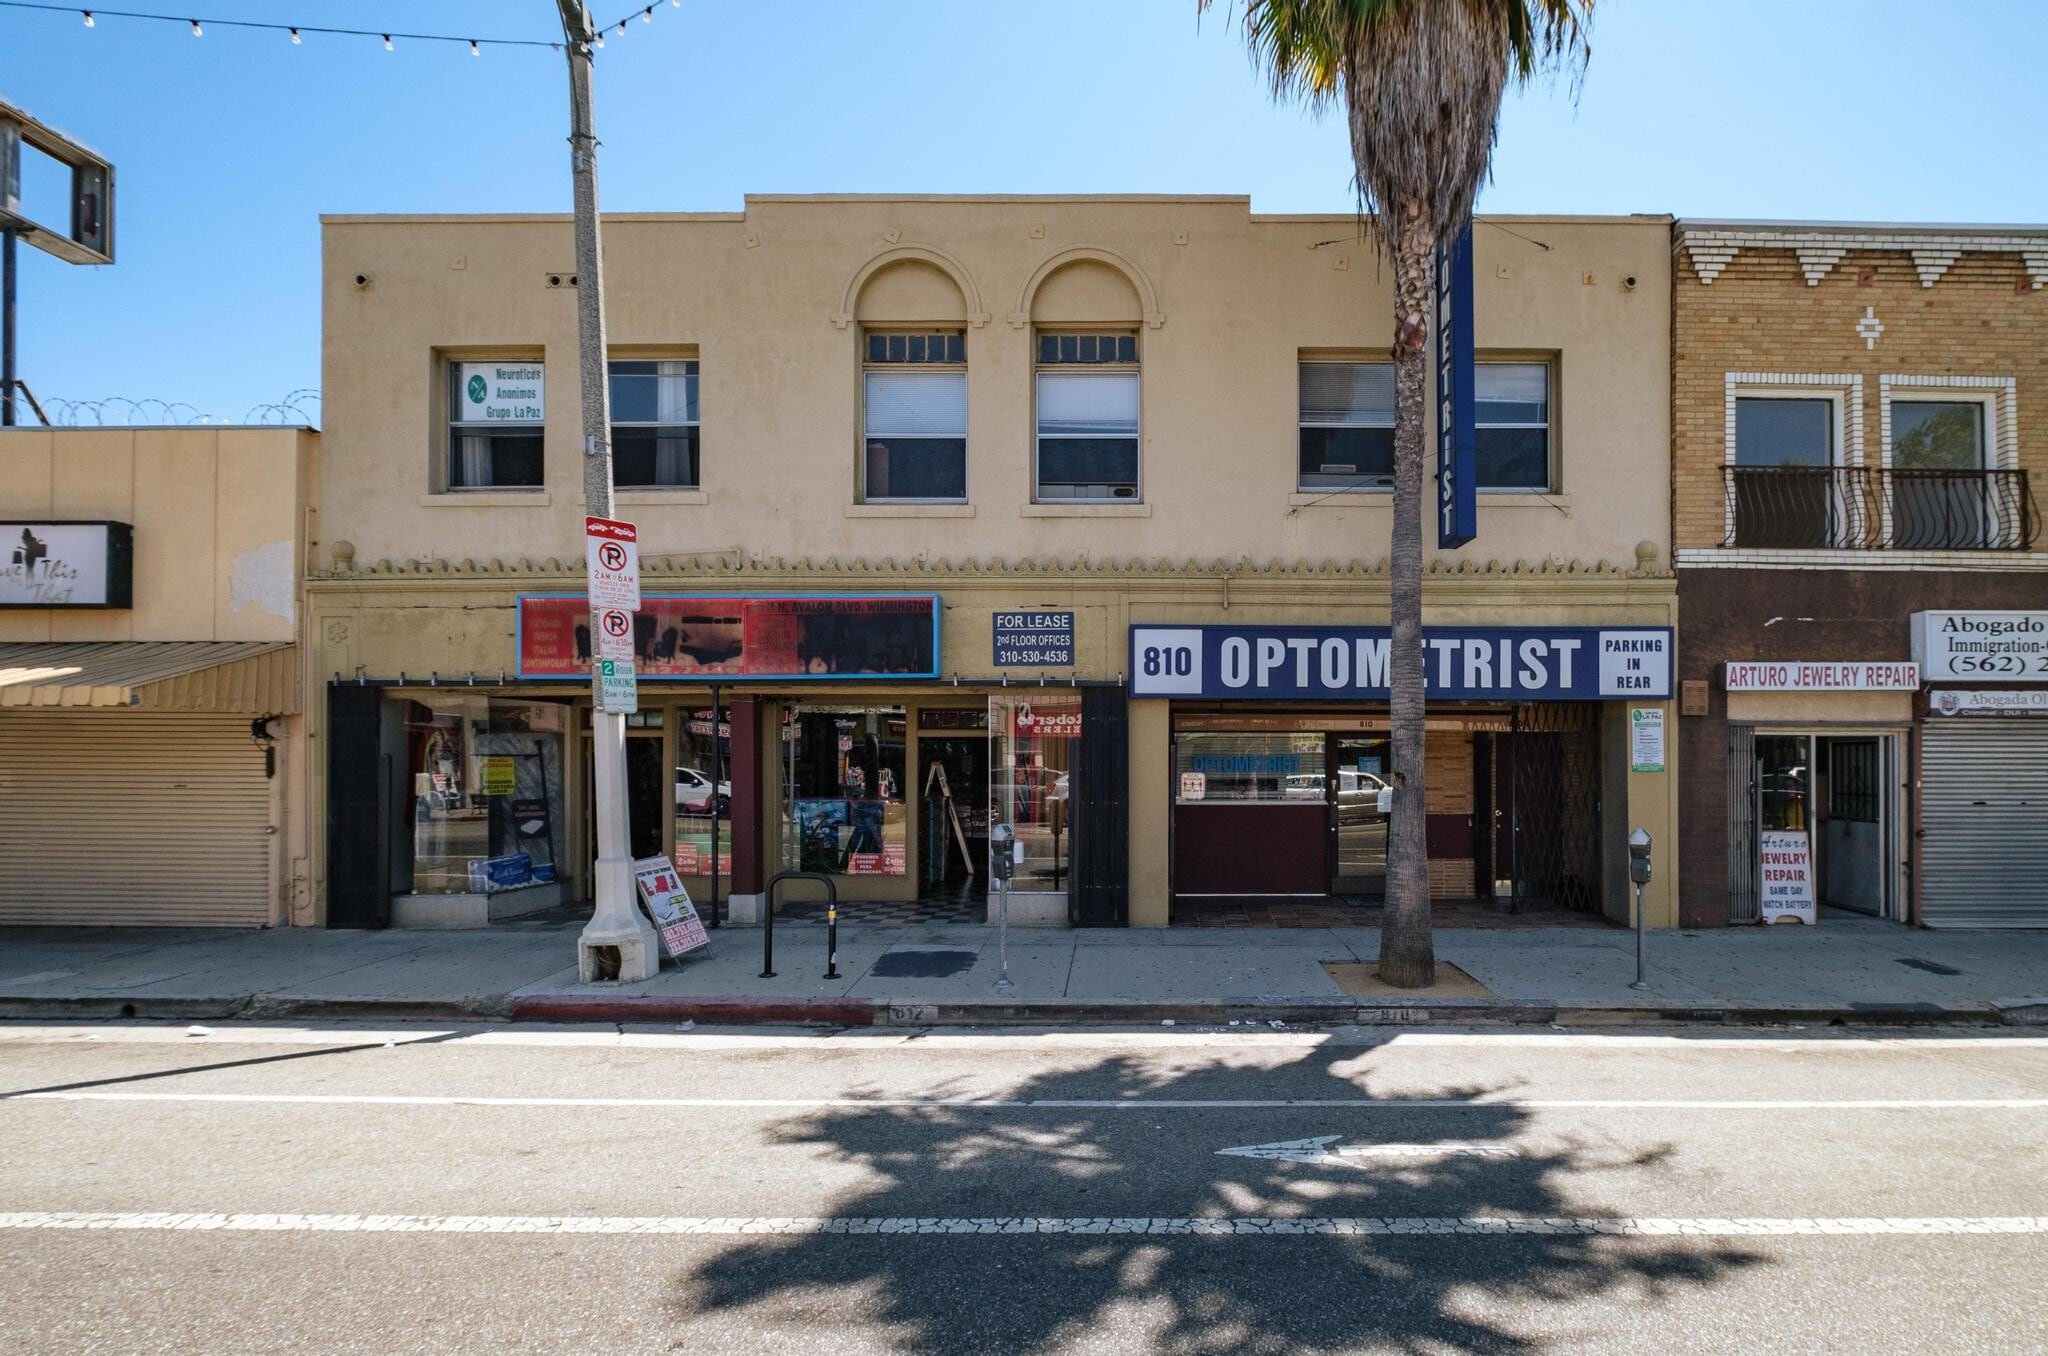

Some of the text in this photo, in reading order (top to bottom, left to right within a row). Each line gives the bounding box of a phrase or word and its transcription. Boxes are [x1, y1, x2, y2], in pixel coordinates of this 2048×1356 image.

[496, 368, 541, 380] Neuroticos
[496, 387, 536, 399] Anonimos
[486, 406, 541, 419] Grupo La Paz
[42, 560, 77, 580] This
[594, 570, 634, 583] 2AM 6AM
[792, 601, 832, 612] AVALON
[837, 601, 862, 612] BLVD.
[868, 600, 933, 612] WILMINGTON
[997, 615, 1070, 628] FOR LEASE
[1942, 617, 2044, 636] Abogado
[997, 634, 1071, 646] 2nd FLOOR OFFICES
[1605, 639, 1663, 652] PARKING
[1948, 636, 2048, 656] Immigration-
[1000, 650, 1068, 662] 310-530-4536
[1144, 646, 1192, 676] 810
[522, 658, 571, 668] CONTEMPORARY
[604, 662, 612, 675] 2
[1220, 637, 1582, 689] OPTOMTRIST
[1627, 658, 1641, 670] IN
[1949, 656, 2026, 675] (562)
[1617, 676, 1651, 689] REAR
[1729, 666, 1916, 687] ARTURO JEWELRY REPAIR
[604, 678, 634, 688] PARKING
[1970, 692, 2028, 707] Abogada
[1359, 720, 1374, 728] 810
[1761, 836, 1807, 849] Arturo
[678, 856, 696, 865] Zelle
[885, 857, 904, 865] Zelle
[1761, 853, 1807, 865] JEWELRY
[1765, 869, 1805, 881] REPAIR
[1769, 886, 1803, 895] SAME DAY
[1763, 900, 1812, 909] WATCH BATTERY
